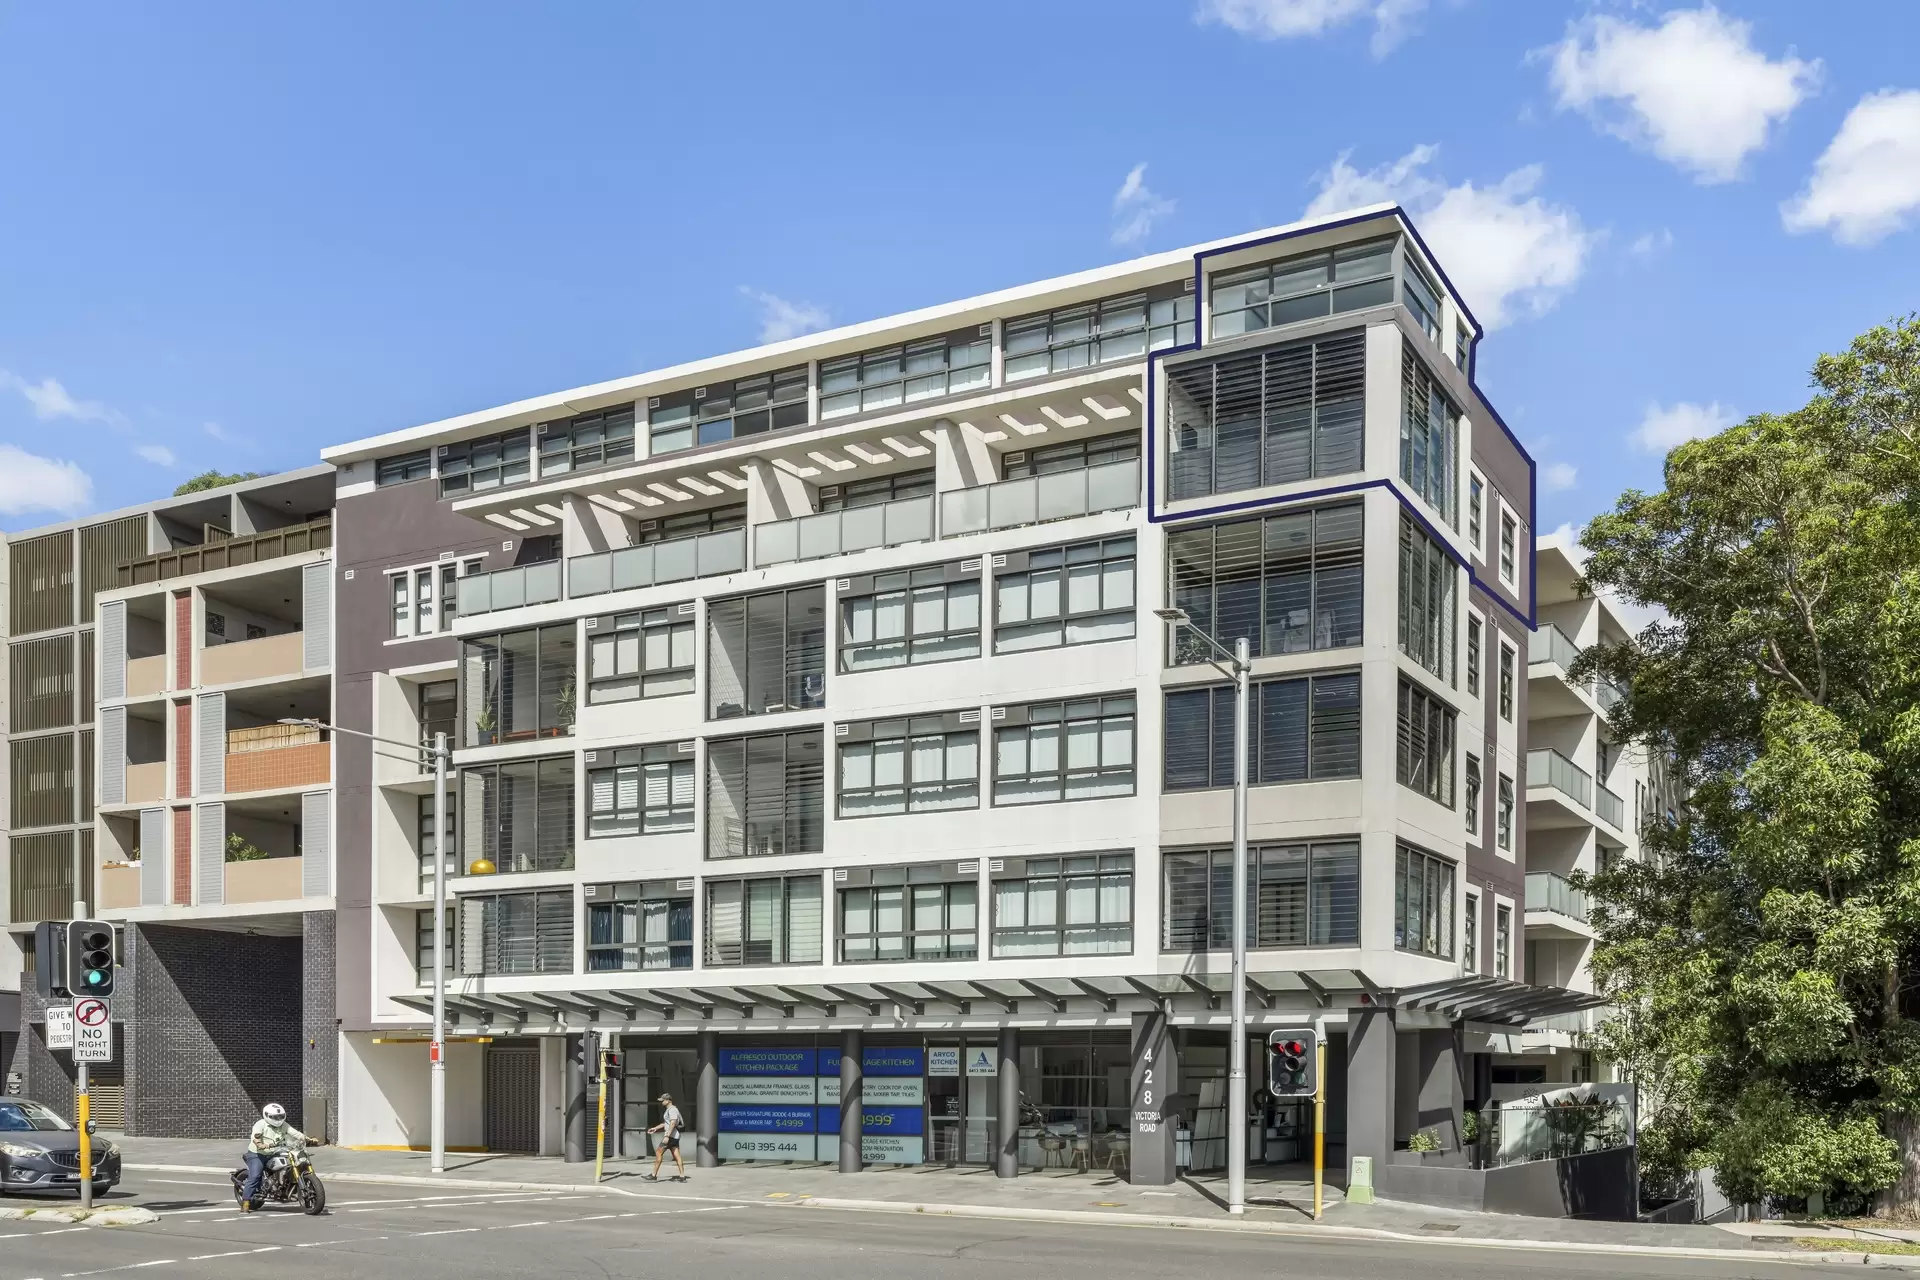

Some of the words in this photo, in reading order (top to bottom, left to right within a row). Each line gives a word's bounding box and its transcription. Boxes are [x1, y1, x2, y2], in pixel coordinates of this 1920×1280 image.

[49, 1011, 65, 1020] GIVE
[62, 1023, 71, 1031] TO
[82, 1029, 103, 1039] NO
[50, 1034, 73, 1044] PEDESTR
[735, 1063, 765, 1071] KITCHEN
[766, 1063, 799, 1071] PACKAGE
[1134, 1111, 1161, 1121] VICTORIA
[1139, 1123, 1156, 1132] ROAD
[734, 1142, 756, 1151] 0413
[757, 1142, 776, 1151] 395
[777, 1143, 798, 1151] 444
